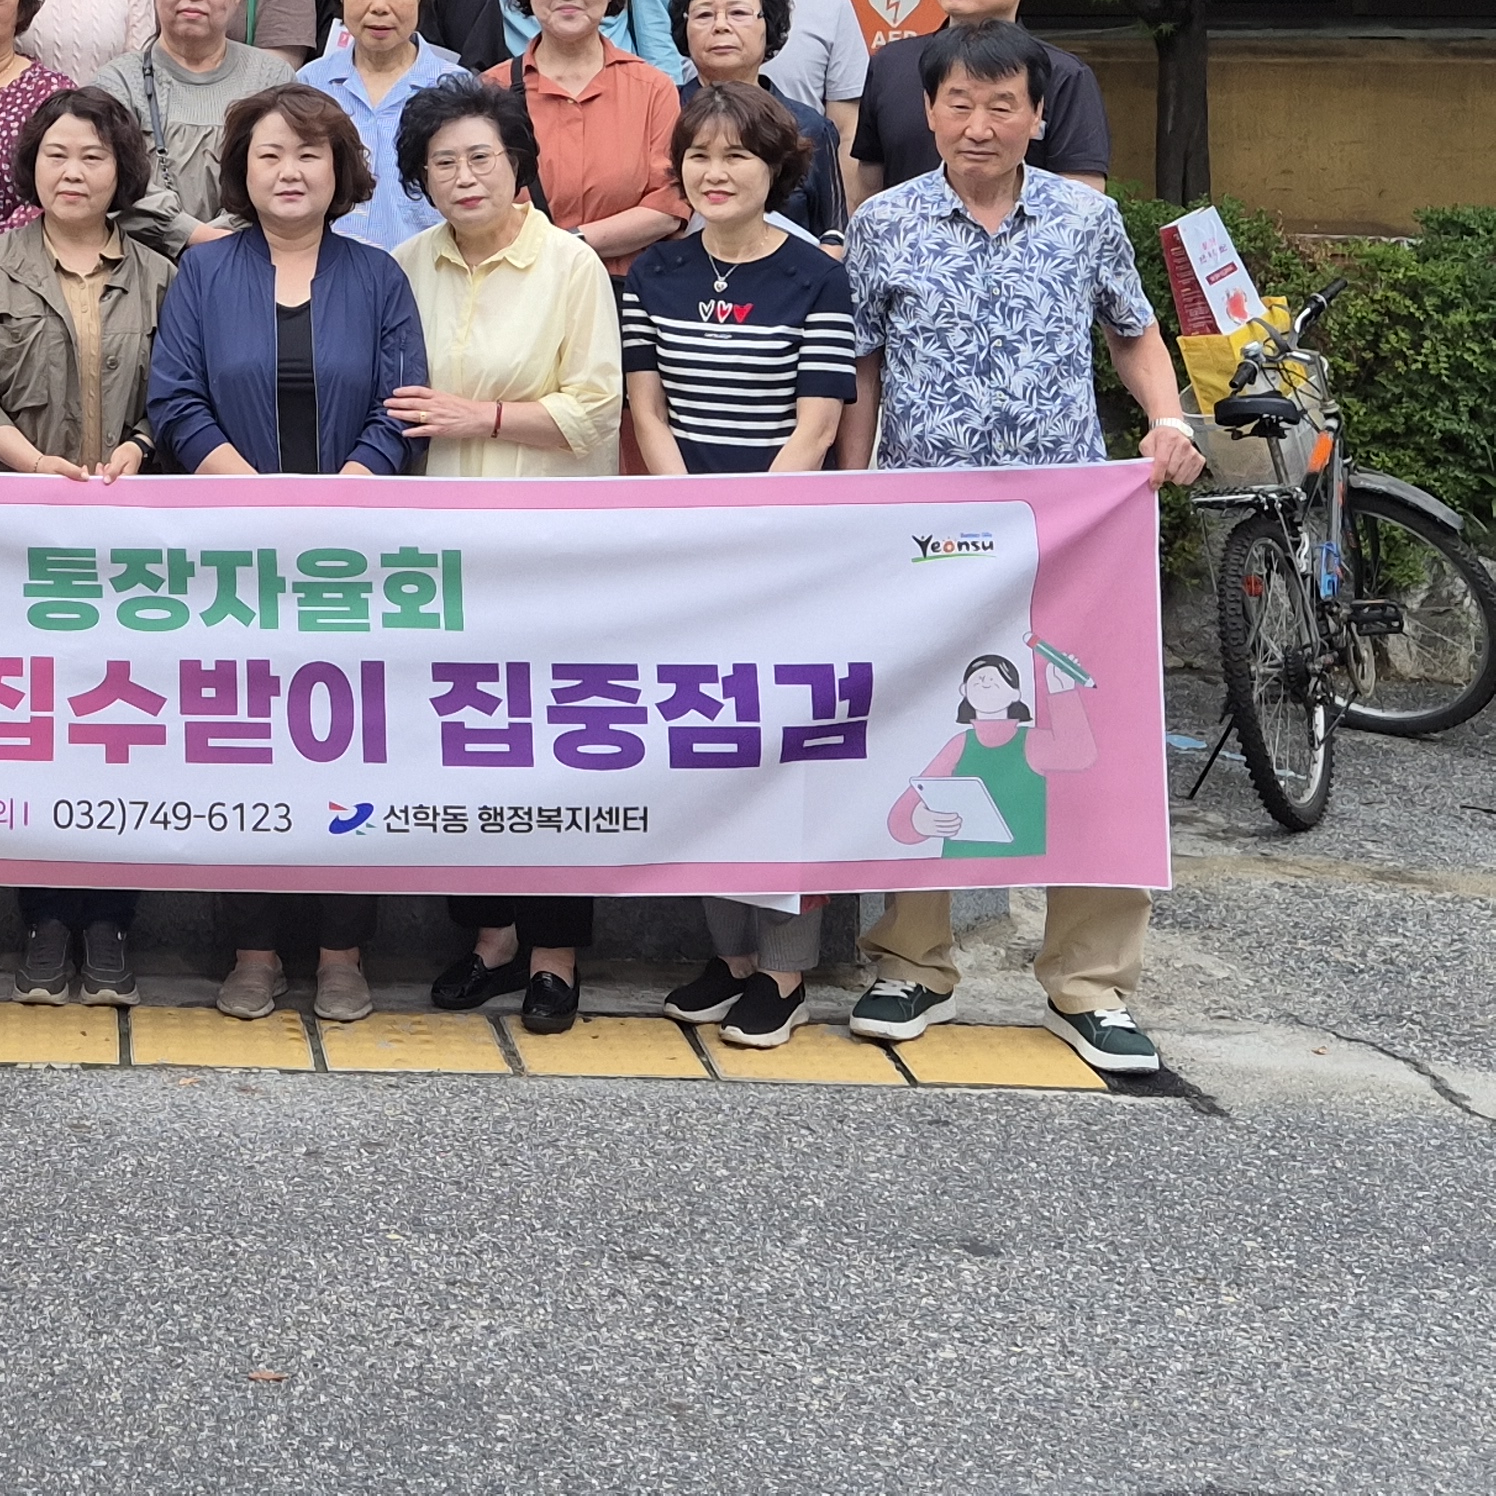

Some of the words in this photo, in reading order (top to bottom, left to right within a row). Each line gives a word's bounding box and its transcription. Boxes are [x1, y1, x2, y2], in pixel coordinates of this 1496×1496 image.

[911, 534, 994, 559] Yeonsu
[23, 546, 464, 632] 통장자율회
[429, 660, 874, 771] 집중점검
[52, 799, 292, 835] 032)749-6123
[383, 804, 469, 834] 선학동
[477, 804, 649, 835] 행정복지센터
